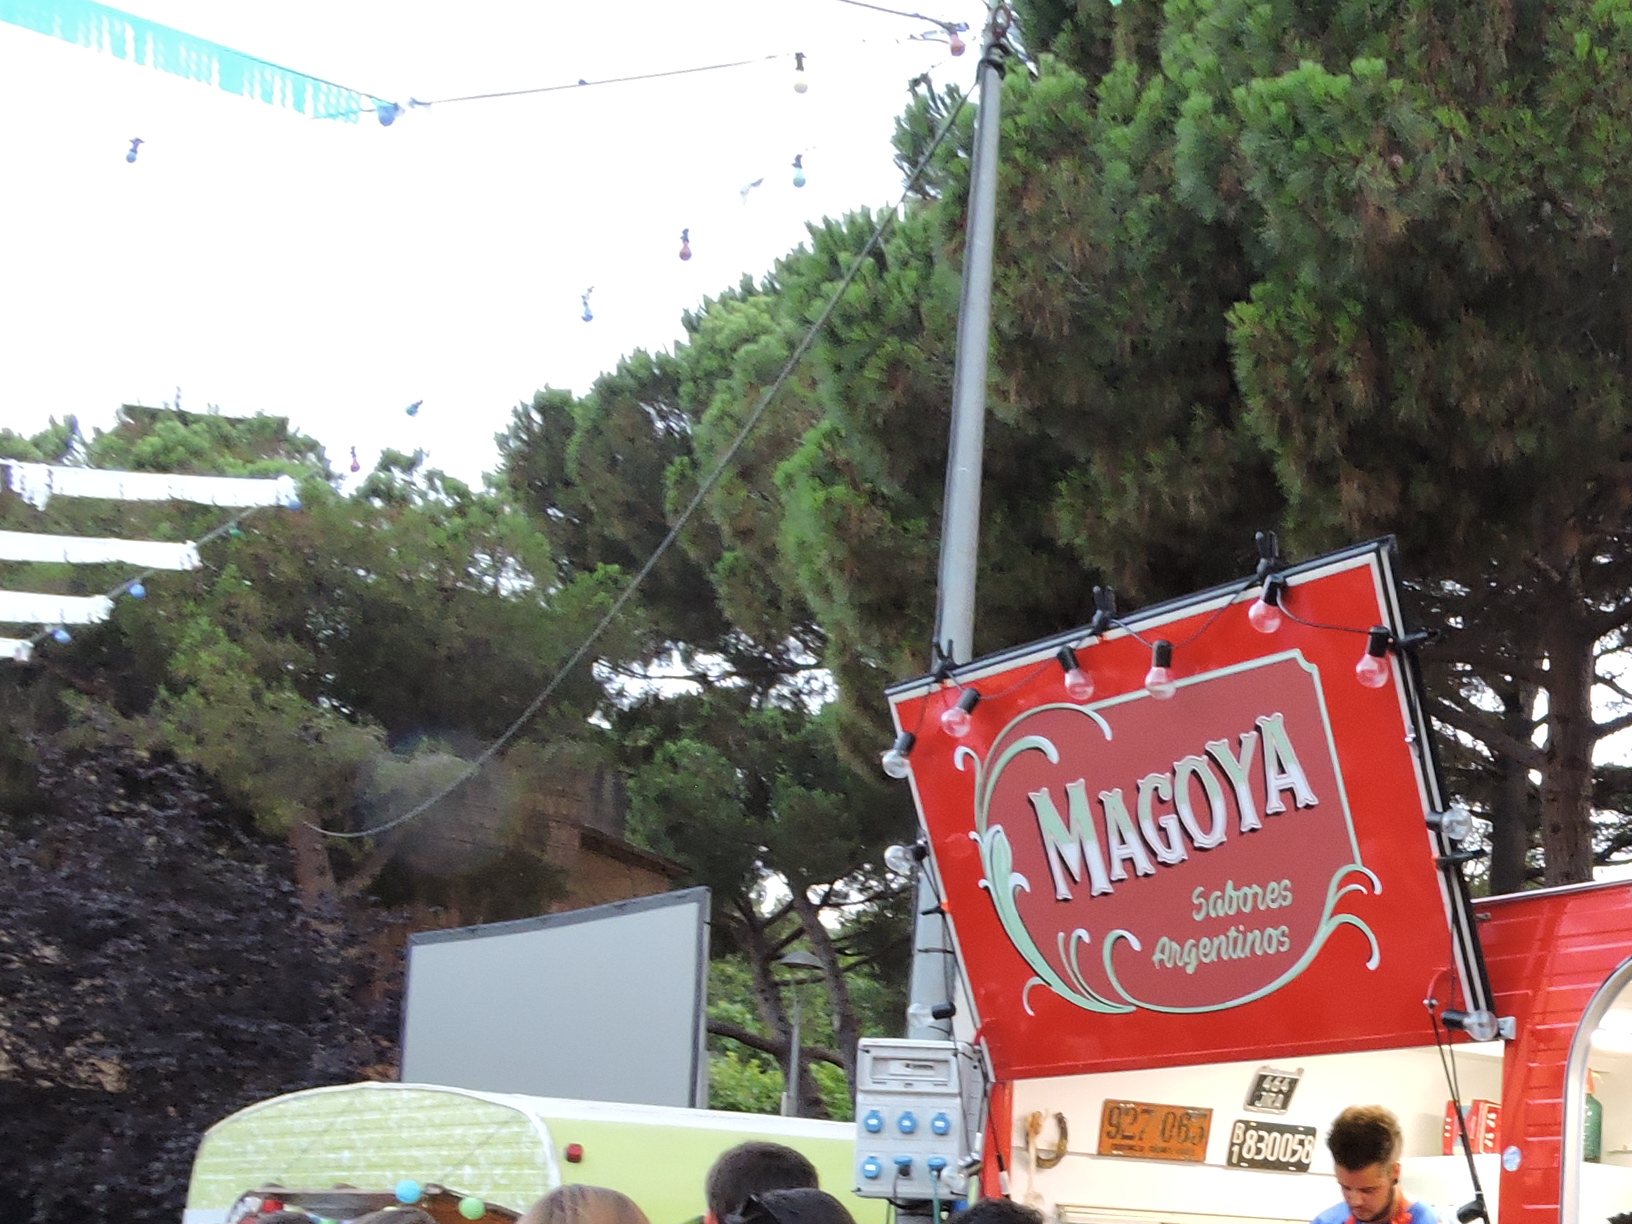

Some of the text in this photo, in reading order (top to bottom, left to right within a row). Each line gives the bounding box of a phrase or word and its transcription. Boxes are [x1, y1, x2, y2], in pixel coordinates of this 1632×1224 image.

[1028, 712, 1319, 901] MAGOYA
[1192, 878, 1293, 921] Sabores
[1152, 924, 1290, 974] Argentinos
[1107, 1106, 1155, 1140] 927
[1242, 1129, 1315, 1164] 830058
